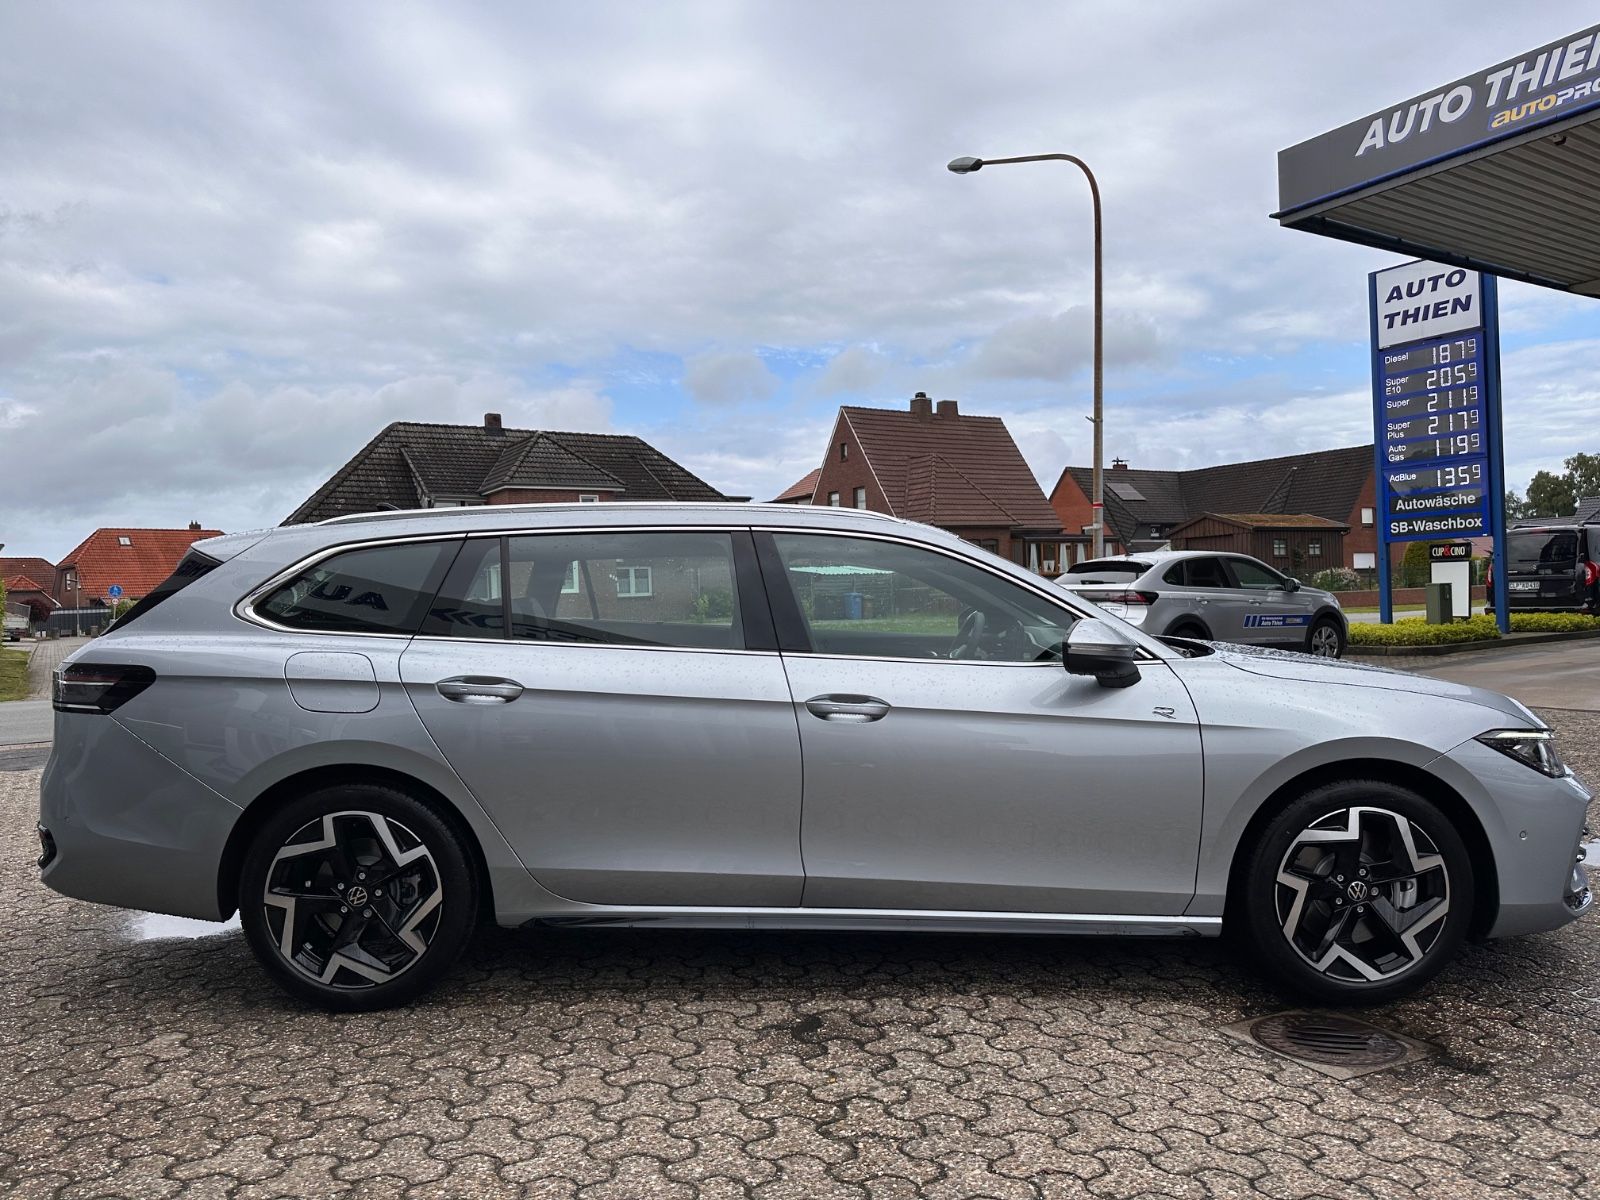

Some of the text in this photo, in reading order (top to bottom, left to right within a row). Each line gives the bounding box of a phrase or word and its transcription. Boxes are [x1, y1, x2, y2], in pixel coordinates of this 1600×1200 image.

[1355, 85, 1473, 157] AUTO
[1385, 269, 1467, 304] AUTO
[1384, 294, 1472, 329] THIEN
[1384, 352, 1409, 365] Diesel
[1385, 376, 1409, 388] Super
[1385, 386, 1402, 396] E10
[1386, 399, 1410, 410] Super
[1387, 421, 1411, 432] Super
[1387, 432, 1405, 440] Plus
[1388, 445, 1407, 453] Auto
[1388, 454, 1405, 462] Gas
[1389, 473, 1417, 483] AdBlue
[1395, 494, 1476, 511] Autowäsche
[1390, 517, 1483, 534] SB-Waschbox
